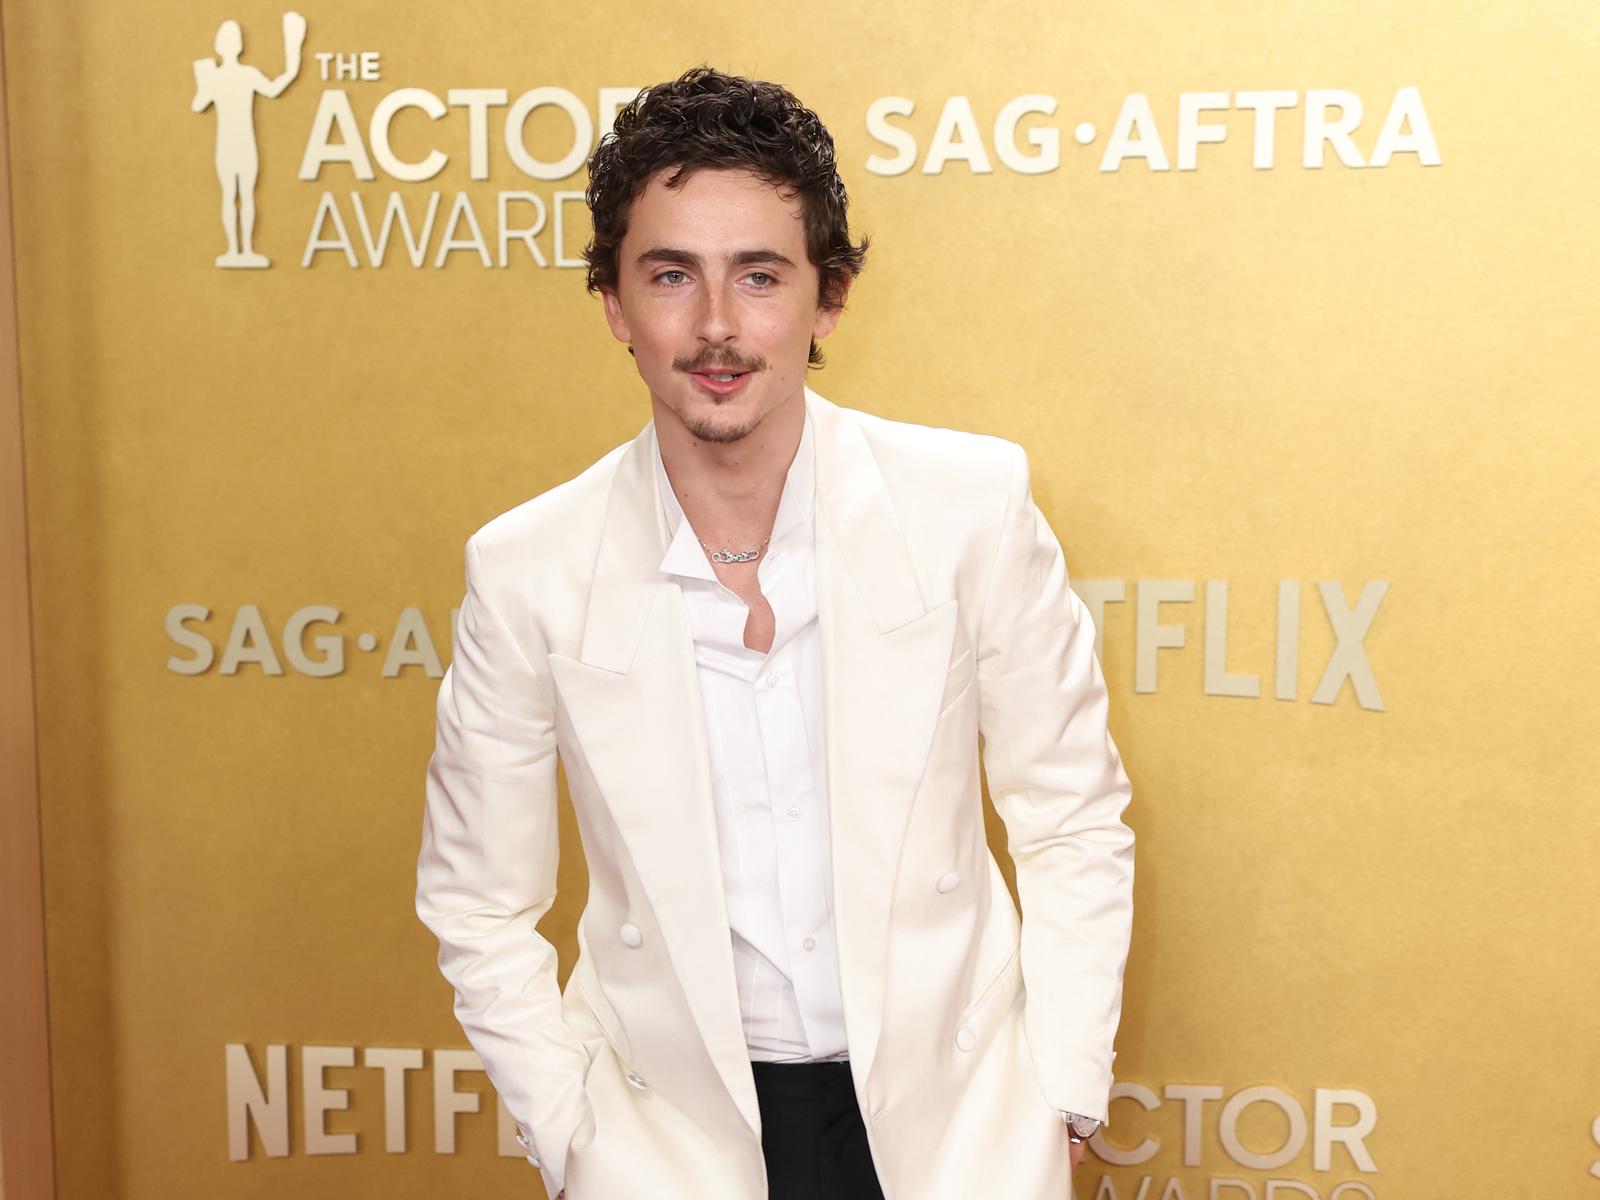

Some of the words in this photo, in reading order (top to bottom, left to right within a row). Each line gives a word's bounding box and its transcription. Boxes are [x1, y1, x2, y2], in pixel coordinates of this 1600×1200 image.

[315, 51, 381, 81] THE
[165, 604, 467, 678] SAG·A
[1087, 1082, 1378, 1173] CTOR
